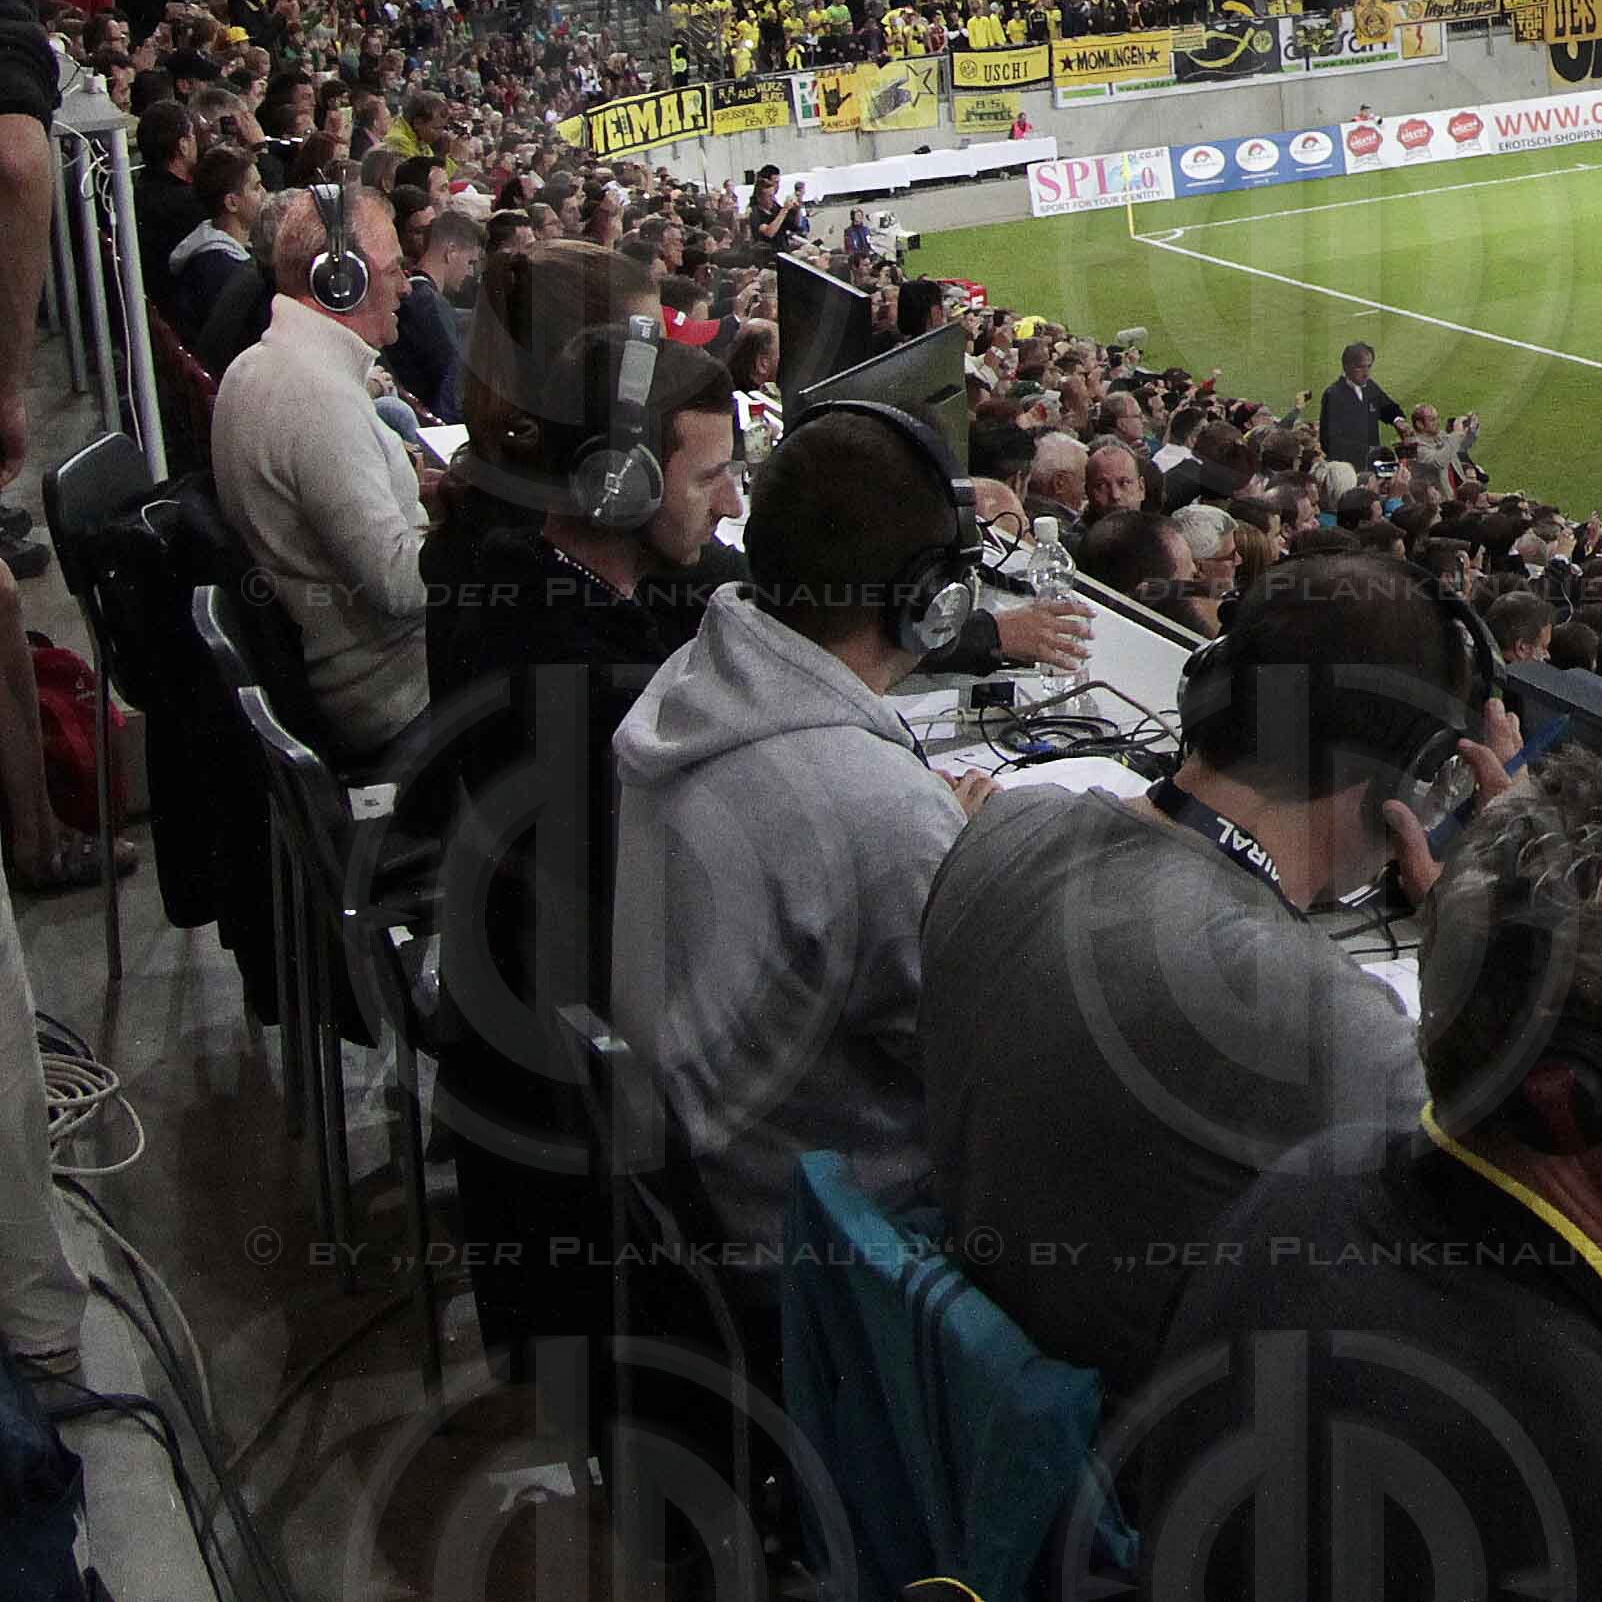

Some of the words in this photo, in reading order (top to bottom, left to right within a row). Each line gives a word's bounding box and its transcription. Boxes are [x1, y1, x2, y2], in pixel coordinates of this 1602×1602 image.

[984, 61, 1029, 83] USCHI
[591, 89, 706, 155] WEIMAR
[1498, 136, 1552, 151] EROTISCH
[1035, 157, 1109, 203] SPI
[1040, 201, 1070, 213] SPORT
[1072, 199, 1091, 208] FOR
